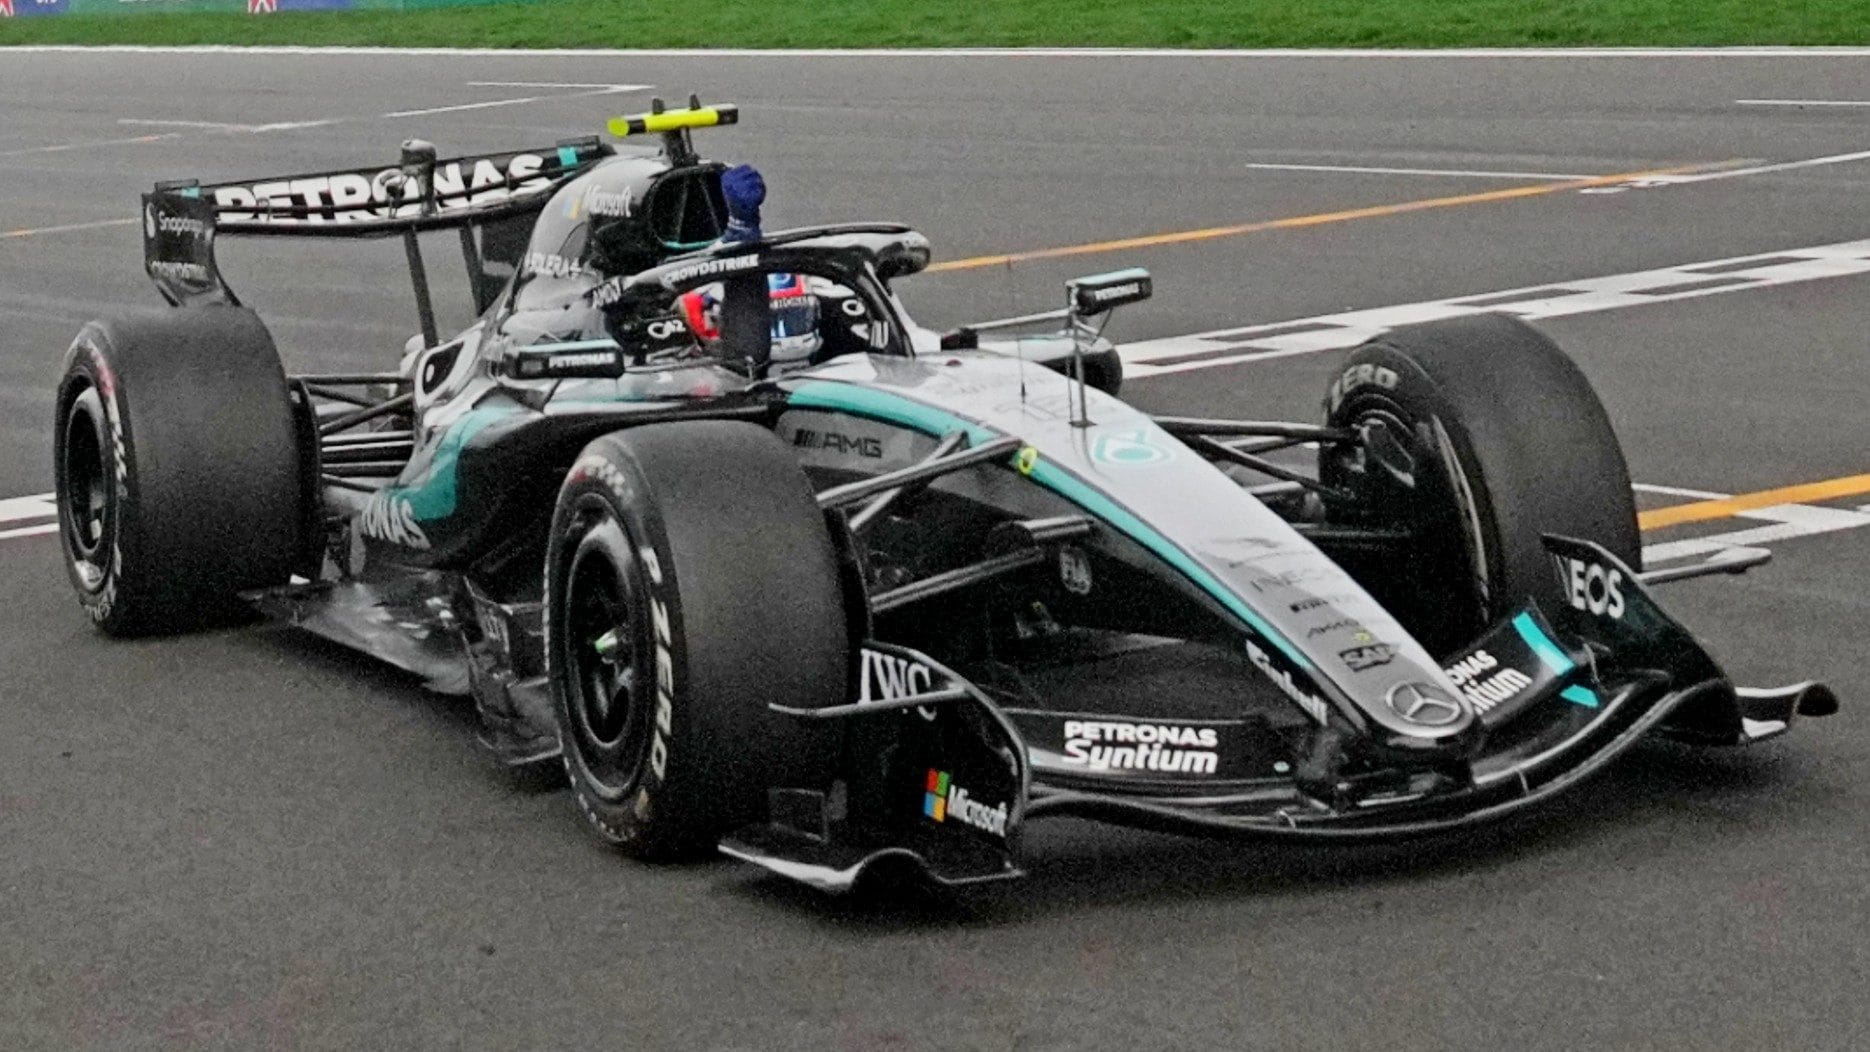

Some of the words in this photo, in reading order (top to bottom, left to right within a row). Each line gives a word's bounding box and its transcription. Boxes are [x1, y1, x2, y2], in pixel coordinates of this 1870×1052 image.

[214, 153, 553, 225] PETRONAS
[662, 254, 759, 289] CROWDSTRIKE
[823, 432, 882, 459] AMG
[651, 597, 674, 781] ZERO
[858, 649, 936, 721] IWC
[1062, 739, 1218, 773] Syntium
[1064, 720, 1218, 748] PETRONAS
[947, 784, 1006, 837] Microsoft
